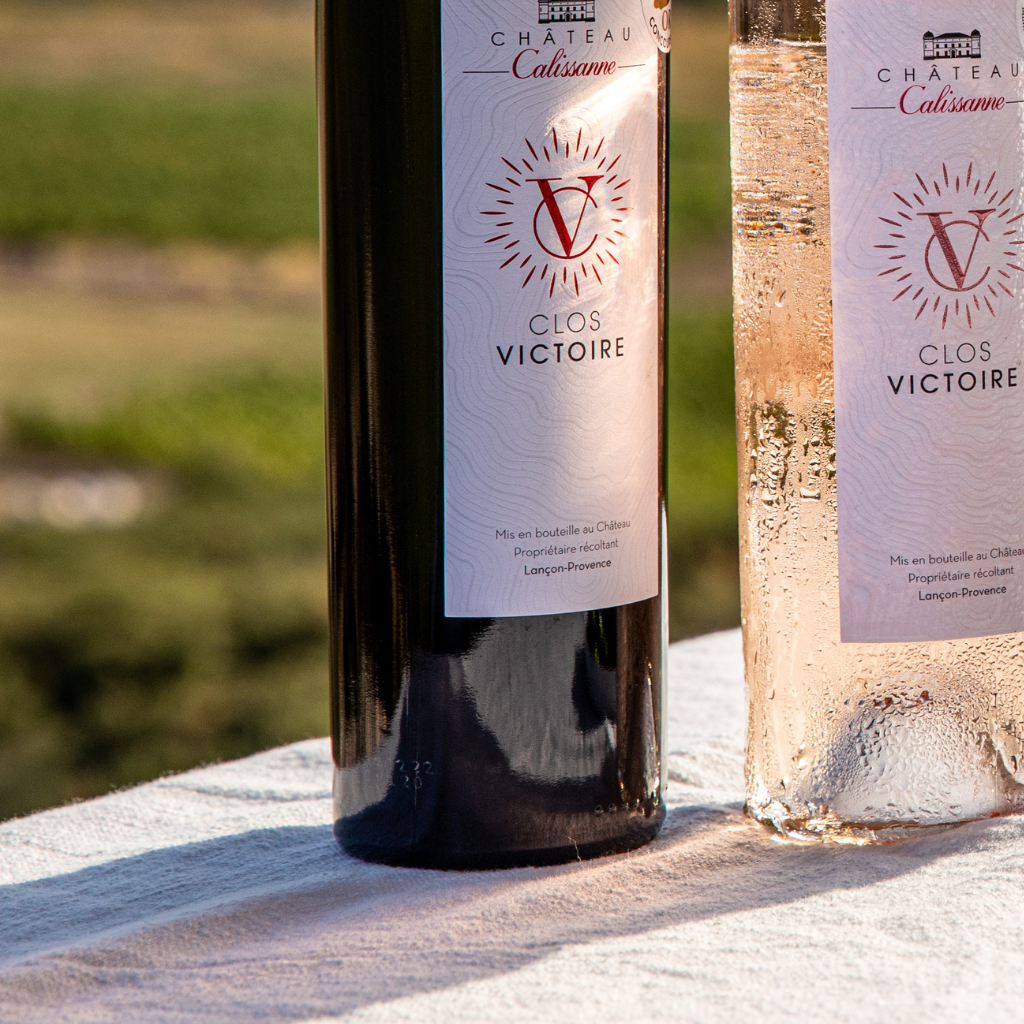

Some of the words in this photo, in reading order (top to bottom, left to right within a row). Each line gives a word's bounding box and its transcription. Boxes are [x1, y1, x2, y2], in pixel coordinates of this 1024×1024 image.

[491, 27, 631, 47] CHÂTEAU
[511, 47, 617, 80] Calissanne
[877, 63, 1020, 83] CHÂTEAU
[899, 84, 1006, 115] Calissanne
[529, 310, 601, 336] CLOS
[496, 337, 624, 365] VICTOIRE
[919, 341, 991, 365] CLOS
[887, 367, 1017, 394] VICTOIRE
[495, 529, 515, 540] Mis
[518, 531, 532, 539] en
[535, 525, 580, 539] bouteille
[582, 527, 594, 535] au
[596, 520, 631, 532] Château
[514, 542, 577, 559] Propriétaire
[579, 538, 618, 553] récoltant
[890, 555, 909, 566] Mis
[912, 557, 926, 565] en
[929, 551, 973, 564] bouteille
[976, 553, 987, 561] au
[524, 559, 612, 576] Lançon-Provence
[908, 570, 971, 585] Propriétaire
[973, 565, 1015, 579] récoltant
[918, 585, 1007, 602] Lançon-Provence
